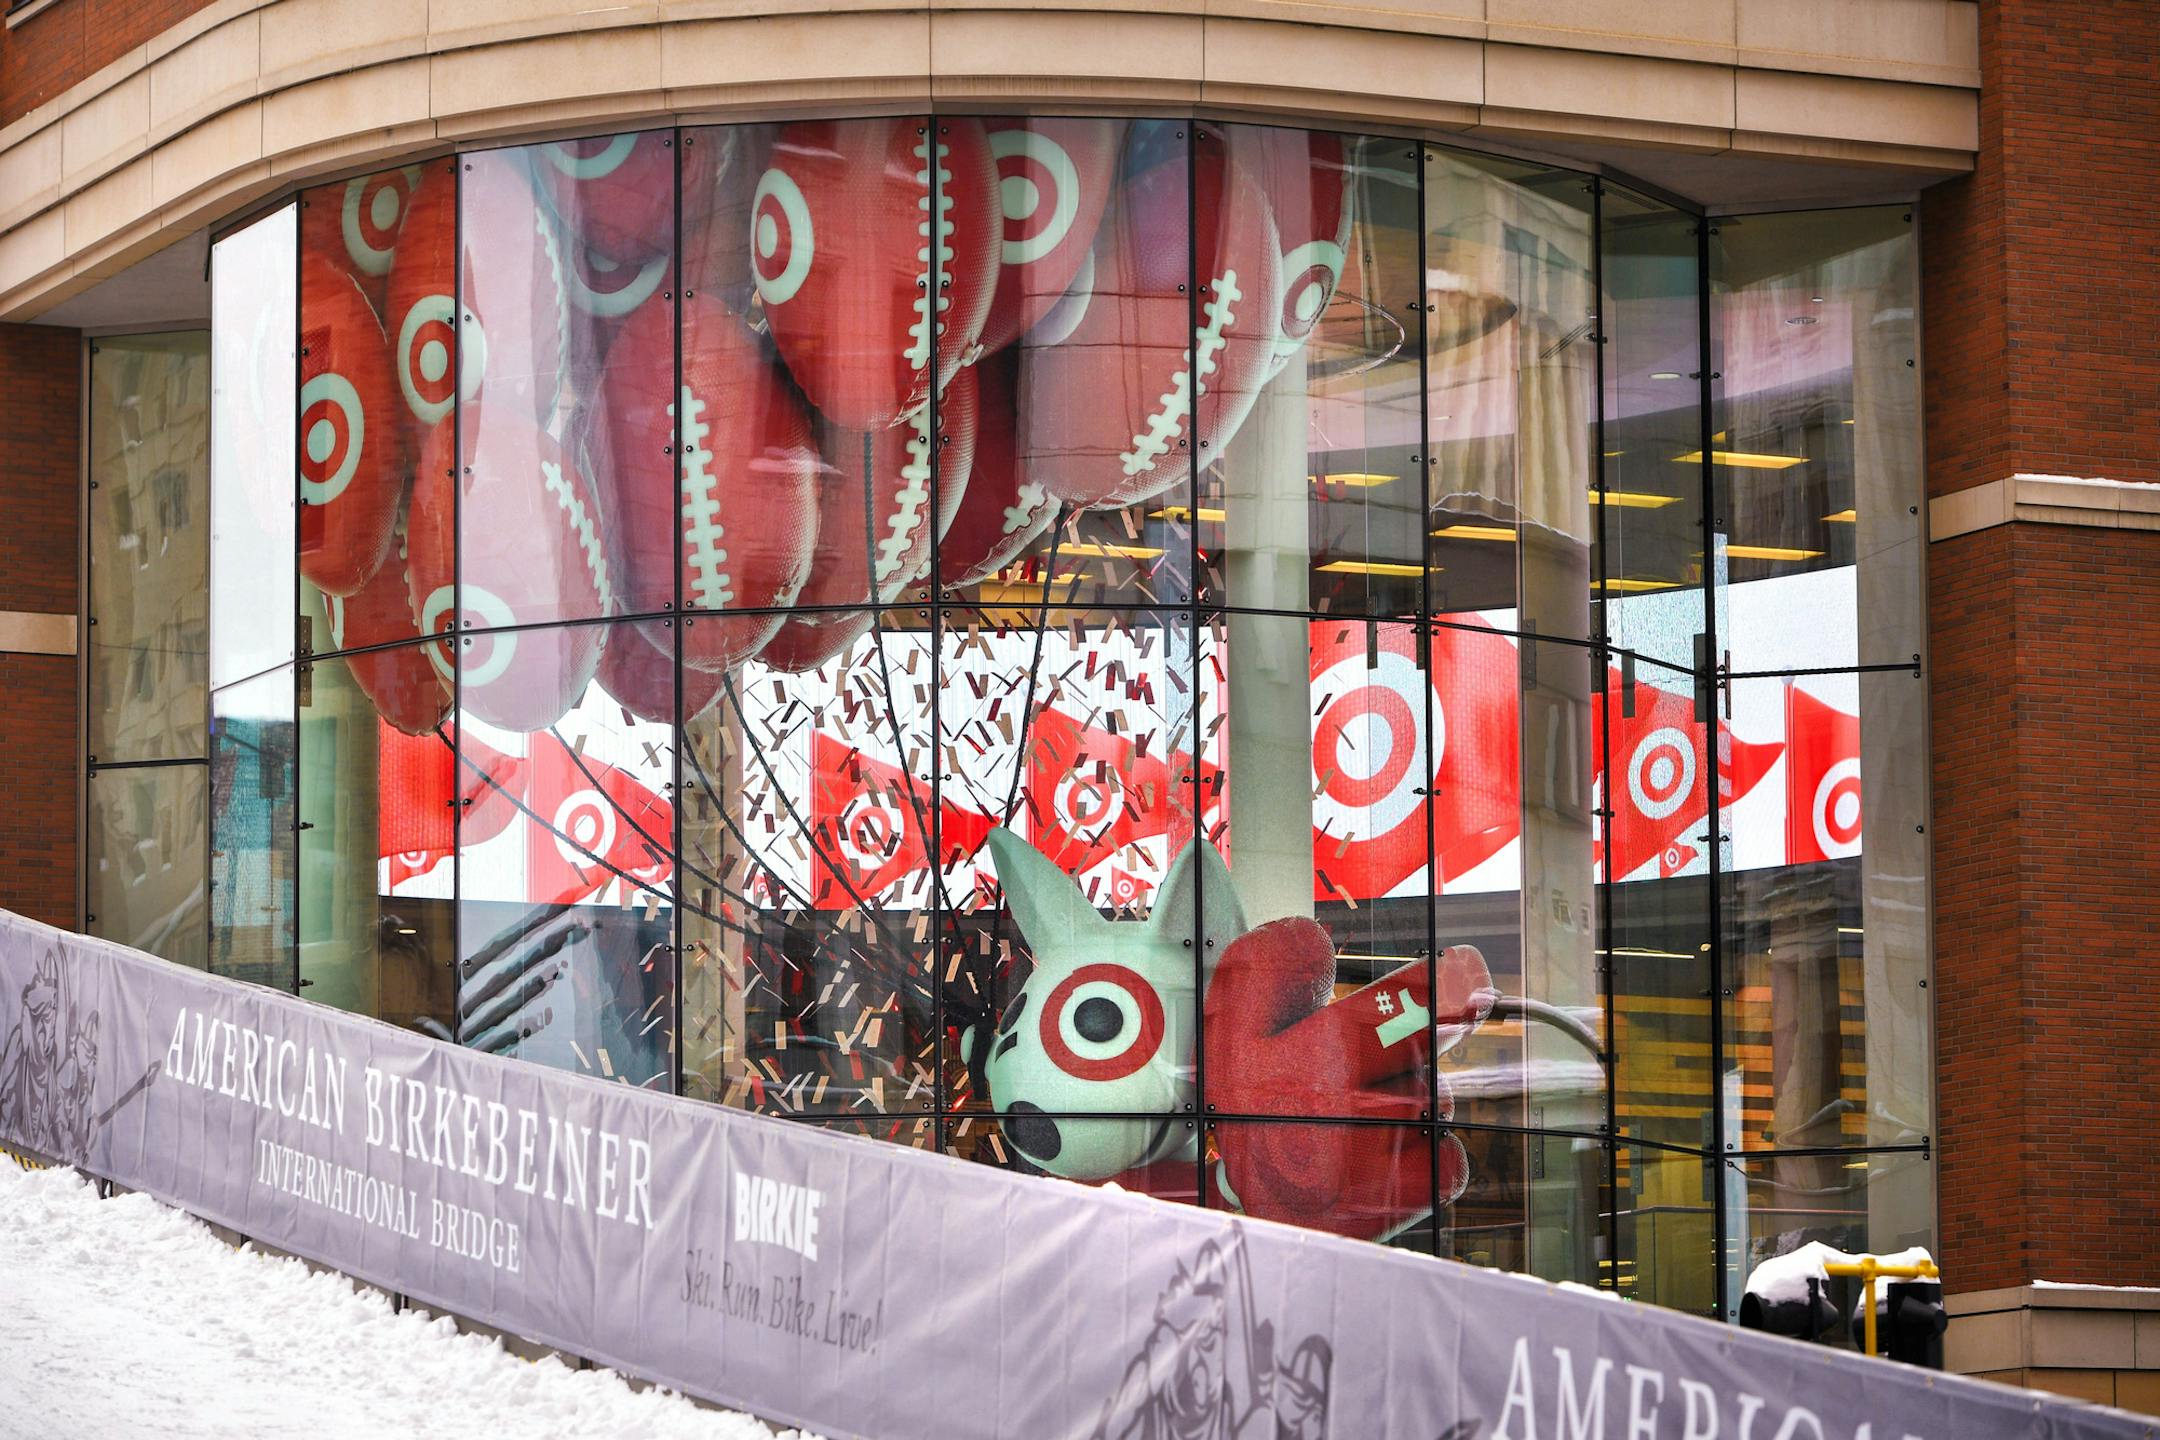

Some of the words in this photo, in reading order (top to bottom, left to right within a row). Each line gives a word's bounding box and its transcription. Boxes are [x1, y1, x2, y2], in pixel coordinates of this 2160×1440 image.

[165, 1007, 347, 1136] AMERICAN
[365, 1066, 654, 1230] BIRKEBEINER
[258, 1139, 420, 1240] INTERNATIONAL
[430, 1198, 520, 1274] BRIDGE
[735, 1171, 821, 1262] BIRKIE
[681, 1249, 714, 1310] Ski.
[719, 1260, 764, 1325] Run.
[768, 1275, 818, 1341] Bike.
[823, 1289, 883, 1356] Live!
